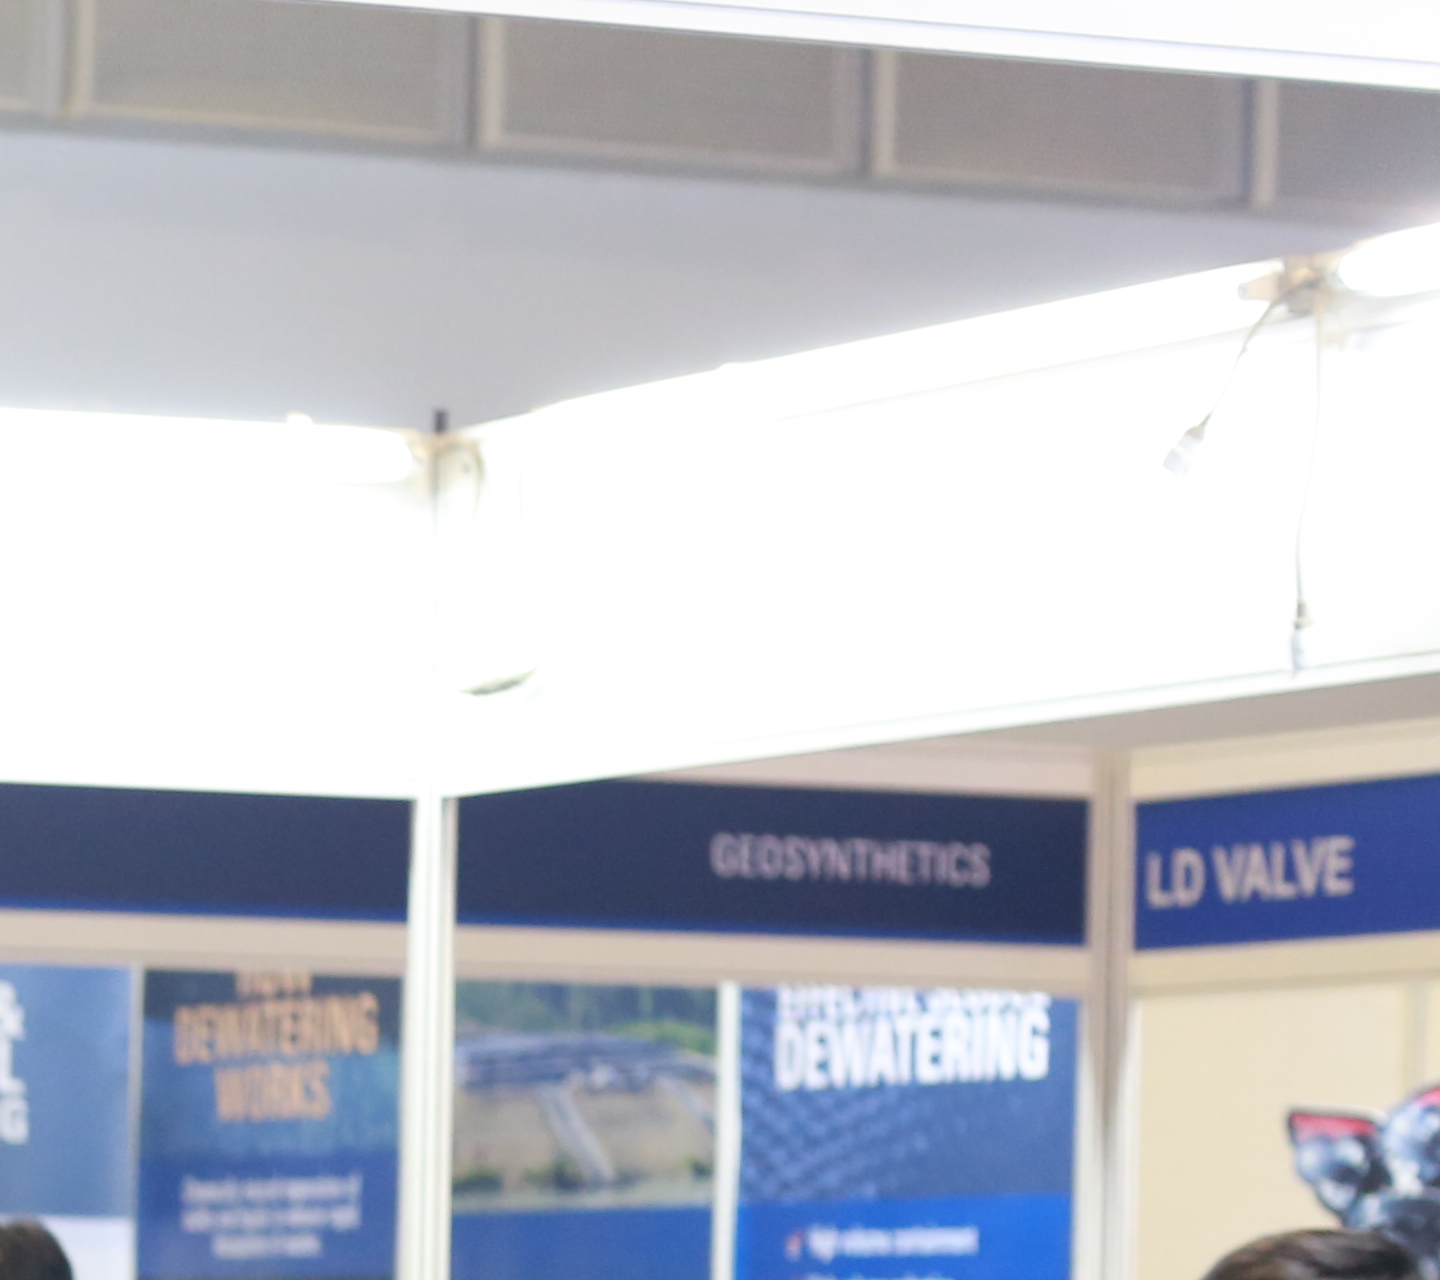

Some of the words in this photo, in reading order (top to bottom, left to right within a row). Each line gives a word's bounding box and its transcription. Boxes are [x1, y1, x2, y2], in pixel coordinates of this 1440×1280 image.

[709, 832, 990, 888] GEOSYNTHETICS
[1145, 849, 1204, 908] LD
[1214, 836, 1354, 903] VALVE
[174, 992, 379, 1066] DEWATERING
[775, 1008, 1051, 1092] DEWATERING
